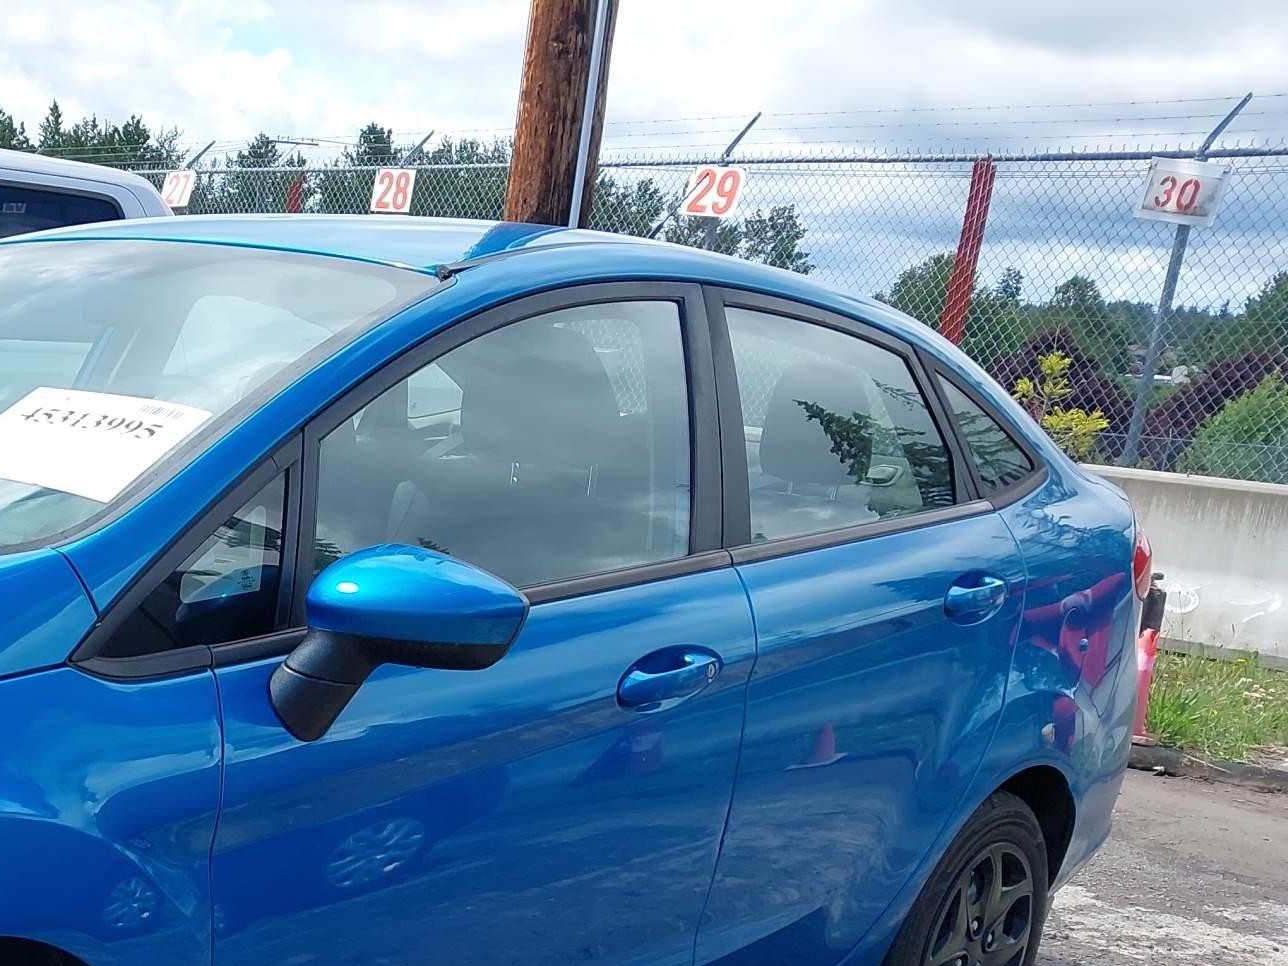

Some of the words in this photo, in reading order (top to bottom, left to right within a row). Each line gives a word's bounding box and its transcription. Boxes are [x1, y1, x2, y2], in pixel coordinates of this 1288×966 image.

[165, 173, 192, 205] 27
[374, 171, 411, 210] 28
[686, 168, 741, 215] 29
[1154, 175, 1201, 211] 30
[20, 407, 164, 440] 45313995
